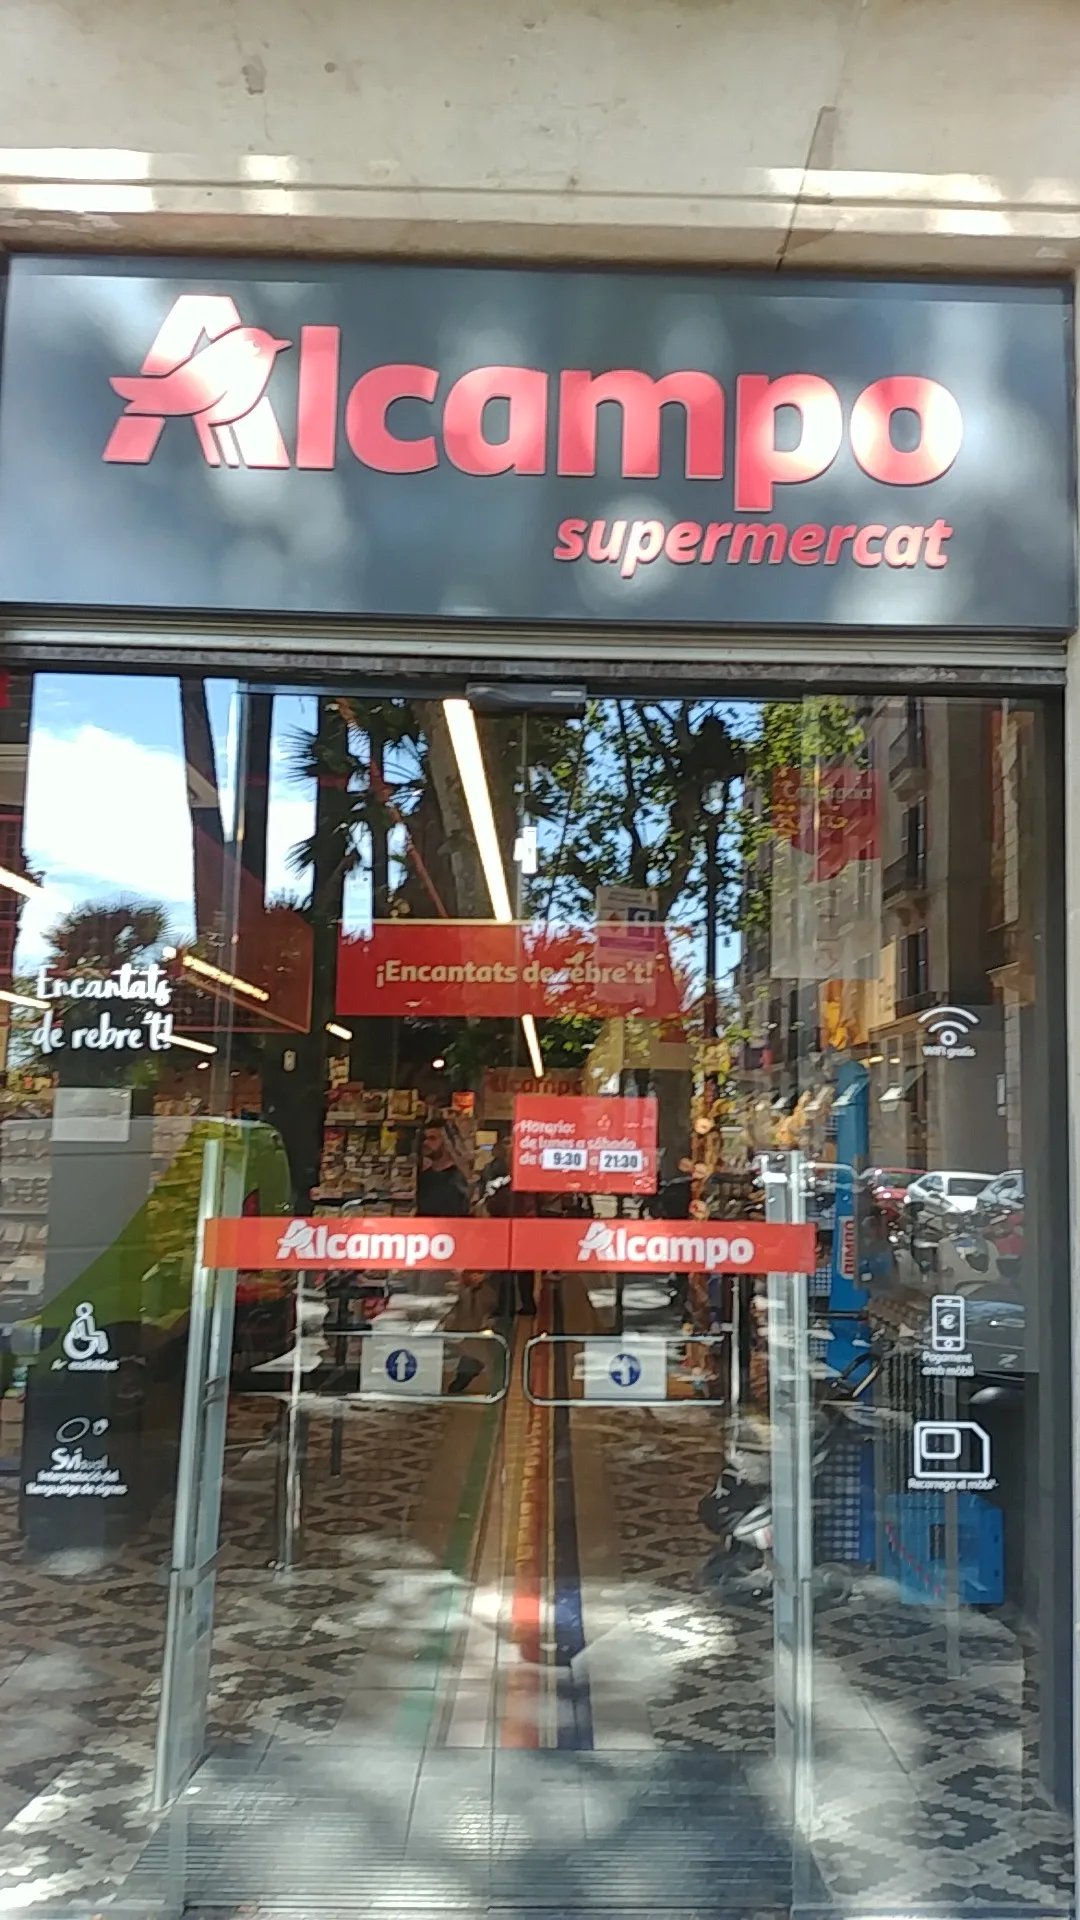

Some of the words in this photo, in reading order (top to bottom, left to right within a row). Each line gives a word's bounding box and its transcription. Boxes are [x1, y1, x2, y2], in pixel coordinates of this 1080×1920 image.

[101, 294, 964, 511] Alcampo
[553, 518, 953, 579] supermercat
[35, 963, 174, 1007] Encantats
[376, 960, 518, 988] ¡Encantats
[522, 960, 553, 983] de
[31, 1009, 66, 1054] de
[519, 1135, 537, 1149] de
[538, 1135, 575, 1149] lunes
[276, 1219, 456, 1267] Alcampo
[577, 1221, 755, 1270] Alcampo
